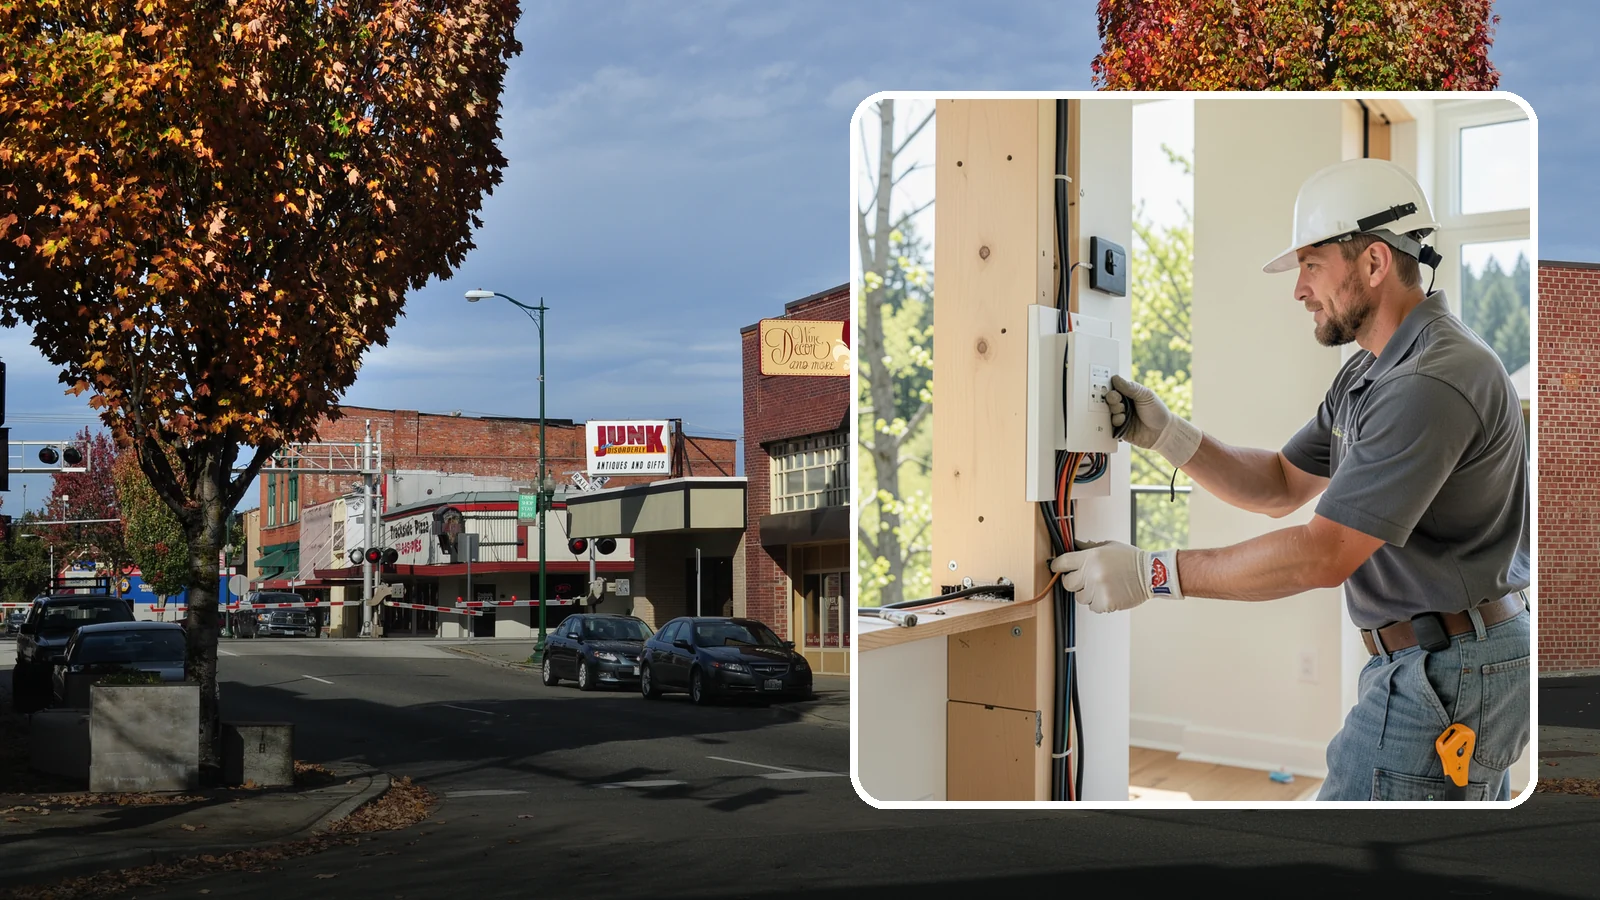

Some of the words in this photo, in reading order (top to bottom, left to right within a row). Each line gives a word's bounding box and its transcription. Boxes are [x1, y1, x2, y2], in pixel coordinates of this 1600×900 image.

[595, 425, 665, 457] JUNK
[607, 446, 646, 454] DISORDERLY
[596, 461, 628, 470] ANTIQUES
[631, 461, 644, 470] AND
[647, 460, 666, 470] GIFTS
[414, 519, 429, 535] Pizza
